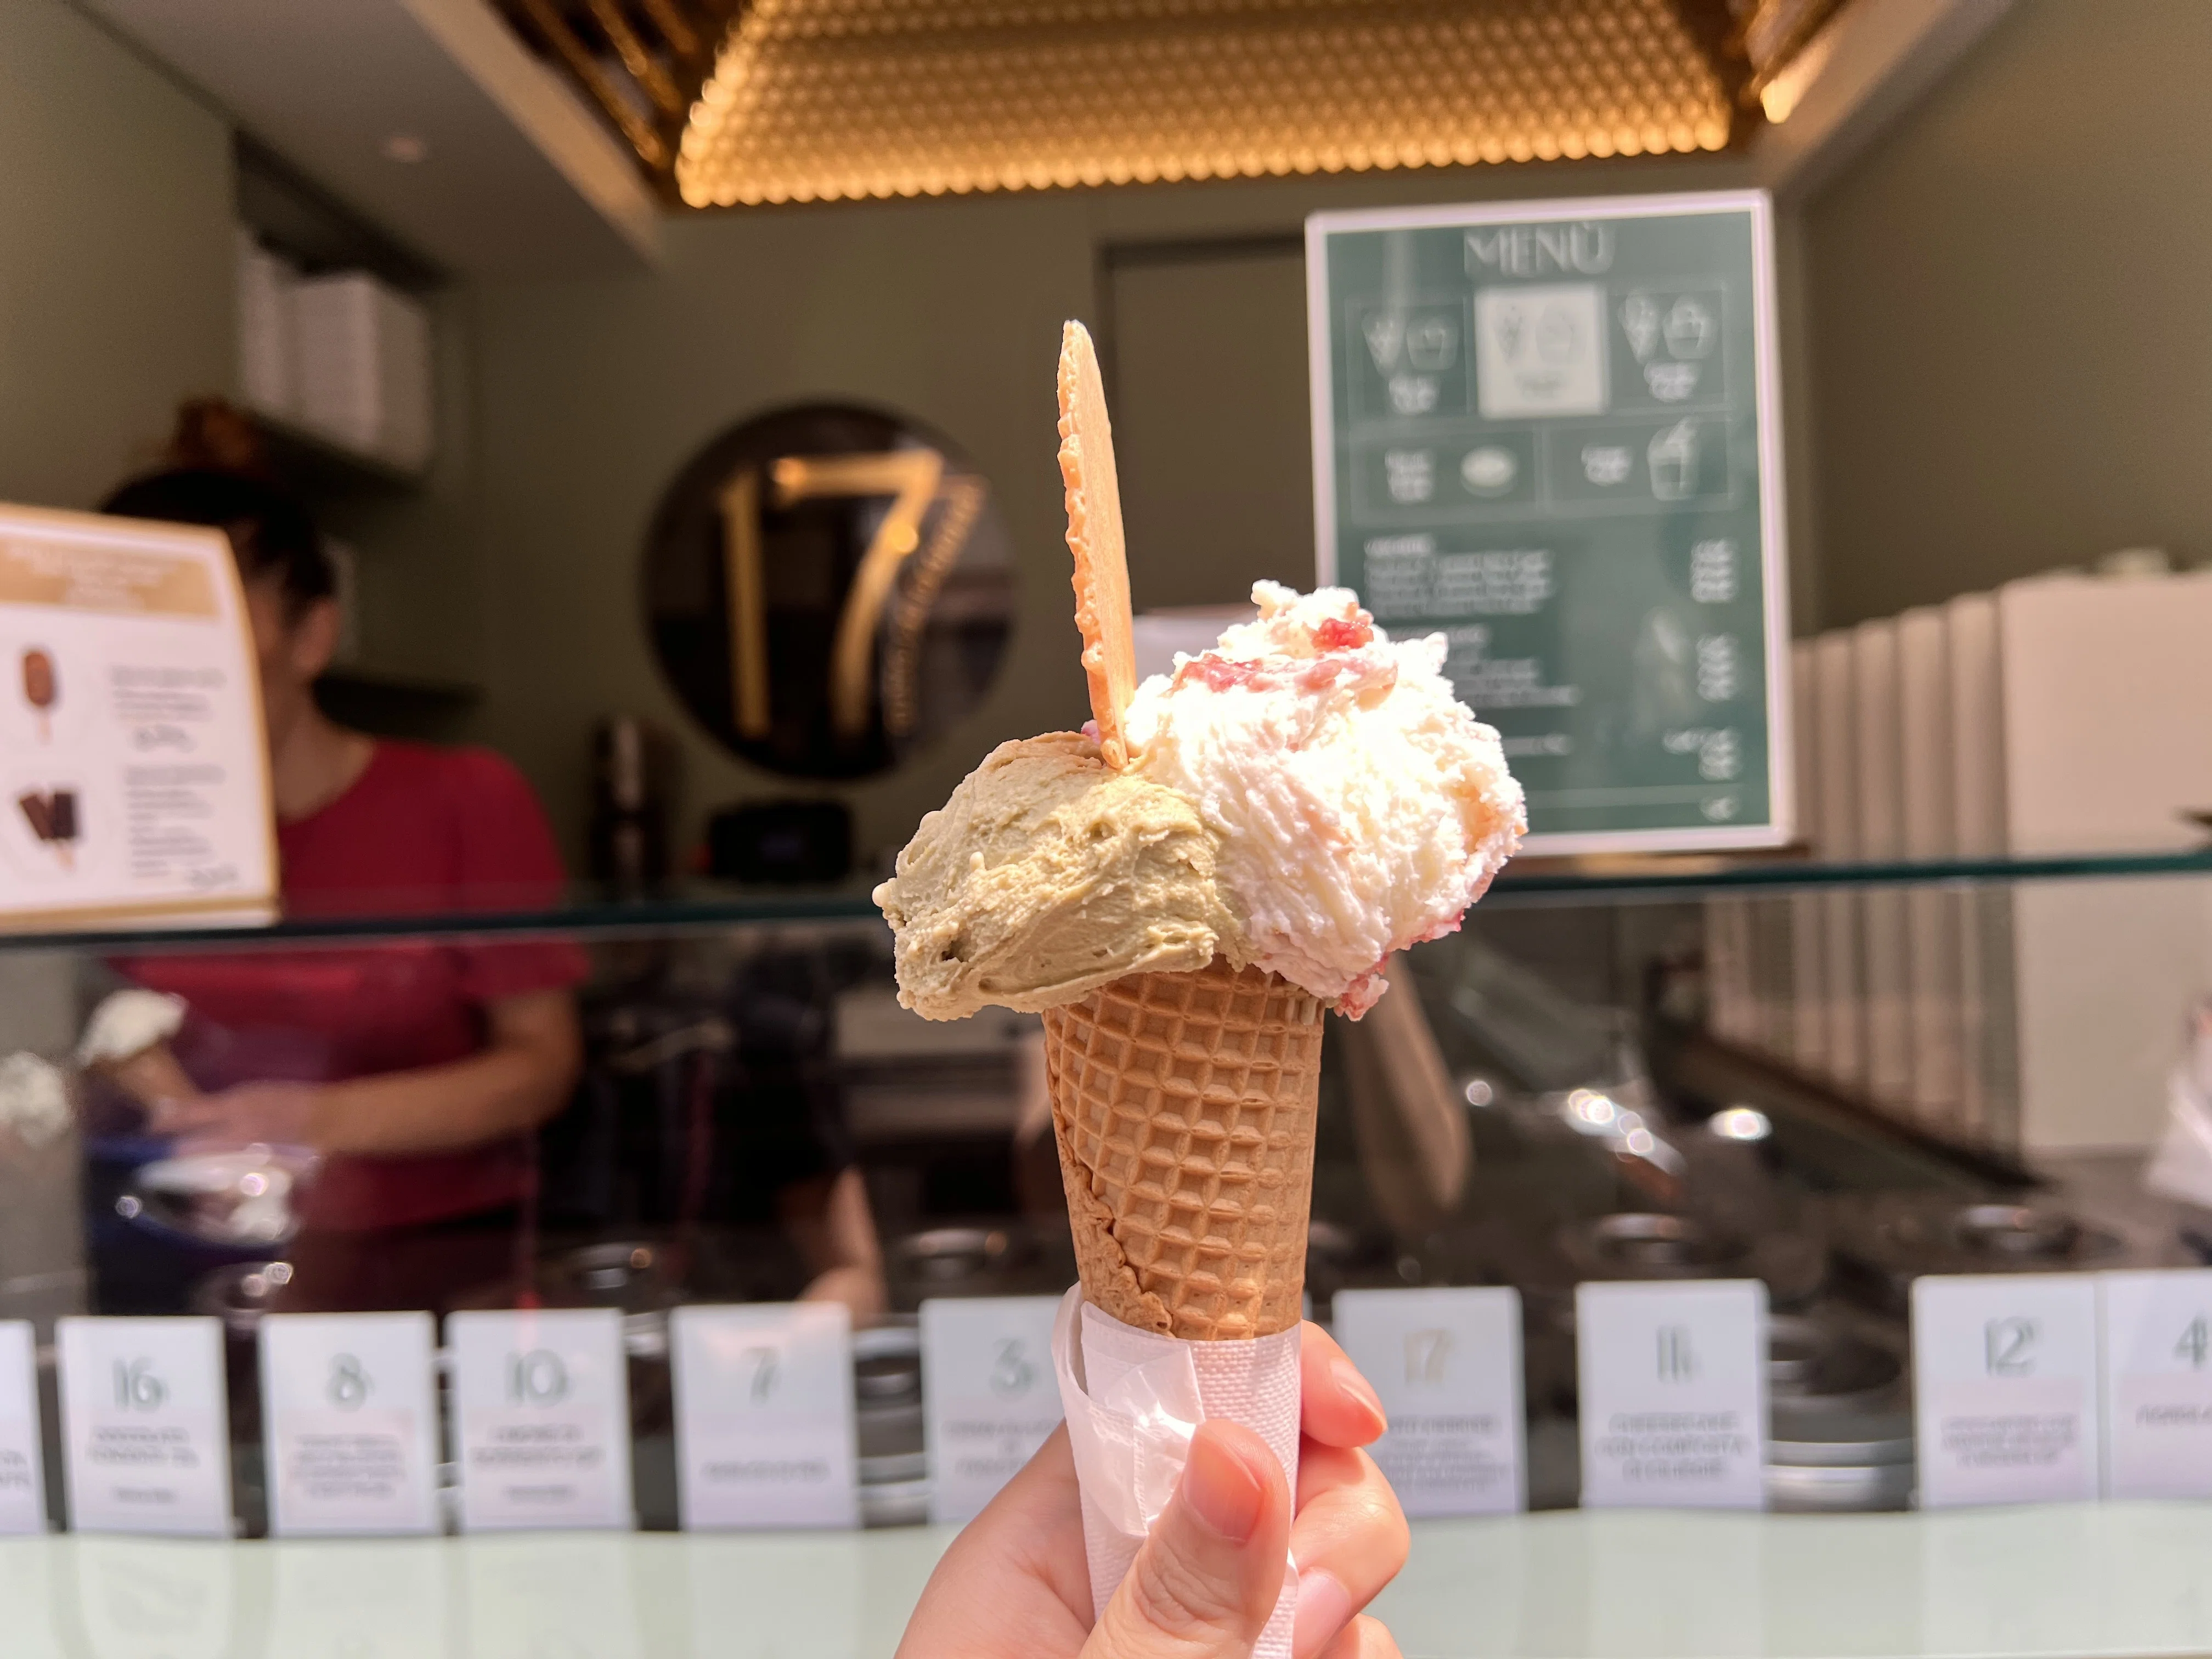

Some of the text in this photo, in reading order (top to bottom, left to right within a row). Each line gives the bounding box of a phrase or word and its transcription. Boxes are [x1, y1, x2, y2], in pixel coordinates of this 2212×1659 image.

[720, 449, 945, 738] 17
[1402, 1327, 1453, 1384] 17
[1984, 1316, 2040, 1377] 12
[2172, 1311, 2210, 1368] 4
[111, 1355, 168, 1412] 16
[326, 1352, 373, 1412] 8
[505, 1348, 569, 1407] 10
[742, 1347, 781, 1406] 7
